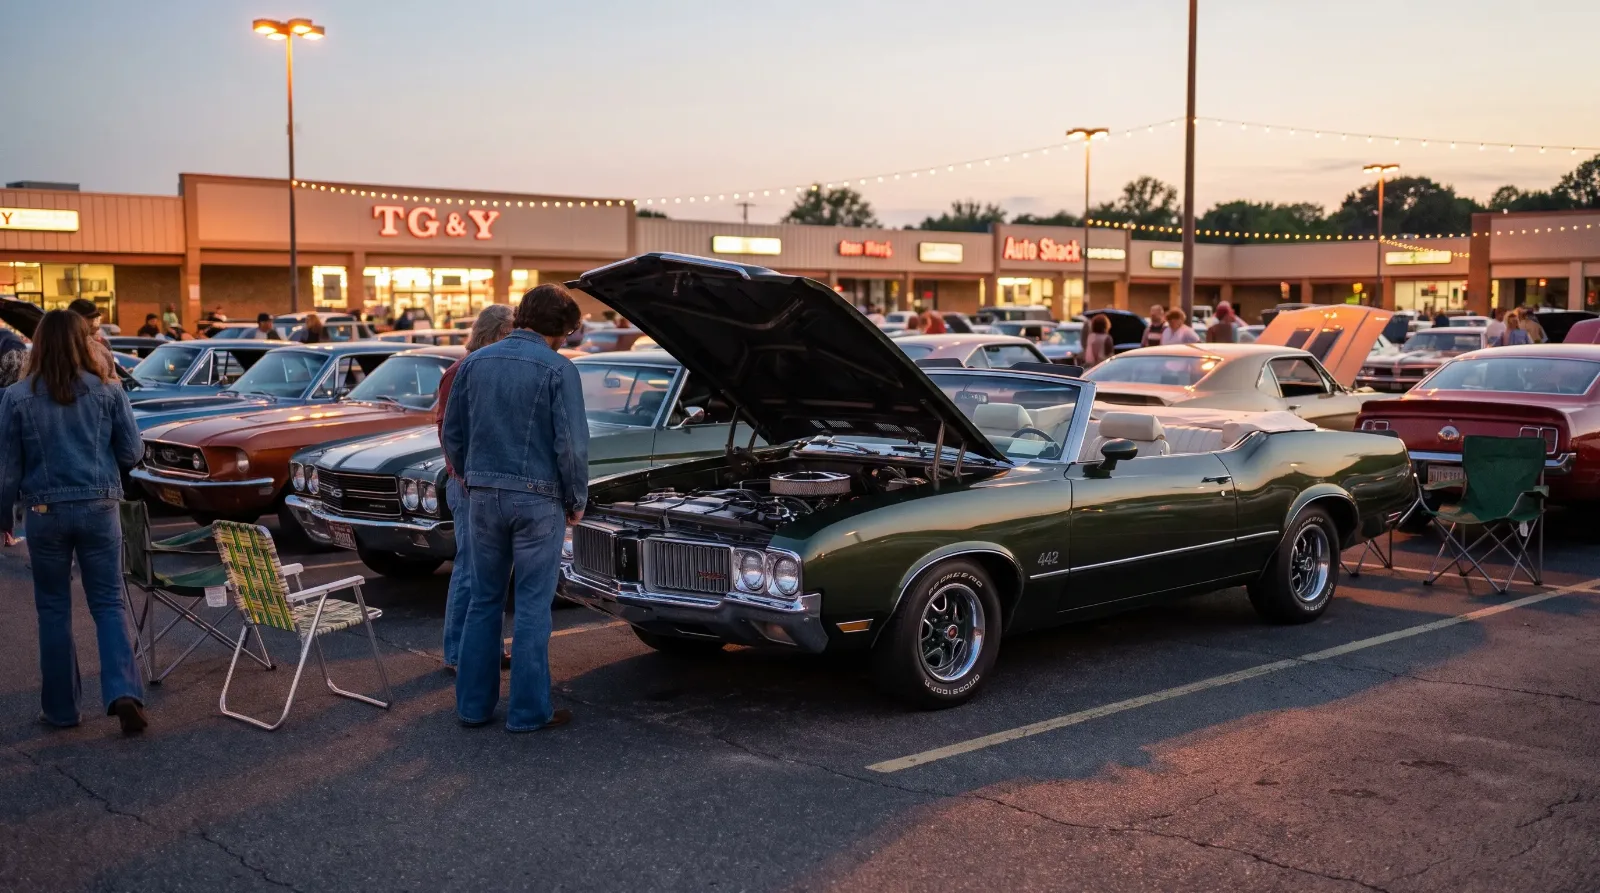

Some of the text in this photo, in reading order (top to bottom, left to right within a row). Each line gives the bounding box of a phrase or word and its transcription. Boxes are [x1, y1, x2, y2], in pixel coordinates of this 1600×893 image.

[372, 205, 501, 241] TG&Y
[1003, 236, 1038, 260] Auto
[1039, 237, 1081, 262] Shack
[1037, 551, 1059, 567] 442
